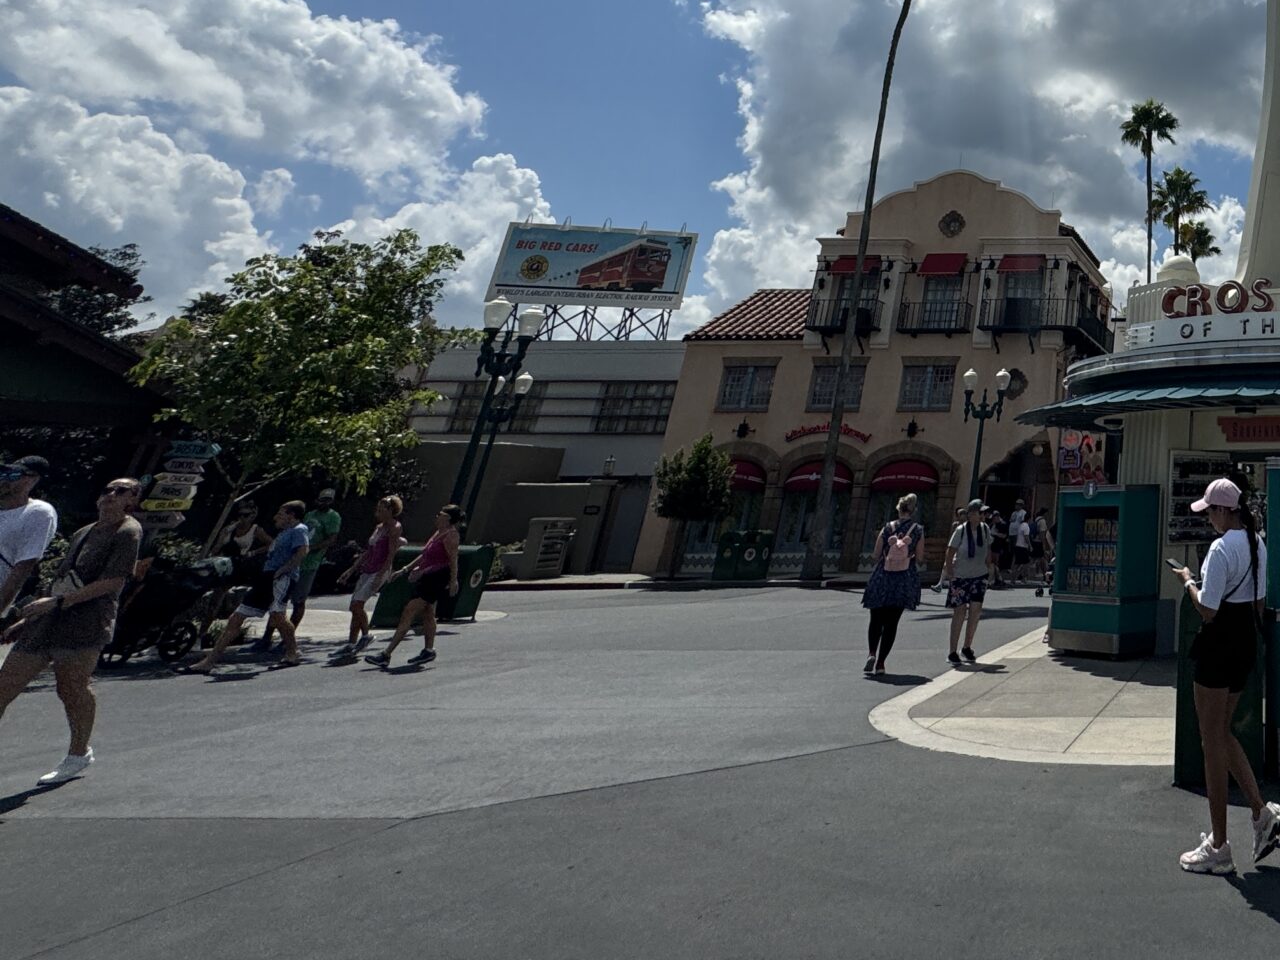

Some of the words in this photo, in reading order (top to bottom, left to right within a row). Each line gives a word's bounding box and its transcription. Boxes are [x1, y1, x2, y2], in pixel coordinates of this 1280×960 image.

[515, 239, 537, 250] BIG
[539, 240, 562, 251] RED
[565, 242, 599, 253] CARS!
[525, 289, 554, 297] LARGEST
[595, 292, 624, 300] ELECTRIC
[1180, 321, 1213, 338] OF
[175, 443, 207, 455] BOSTON
[171, 460, 195, 470] TOKYO
[159, 486, 183, 496] PARIS
